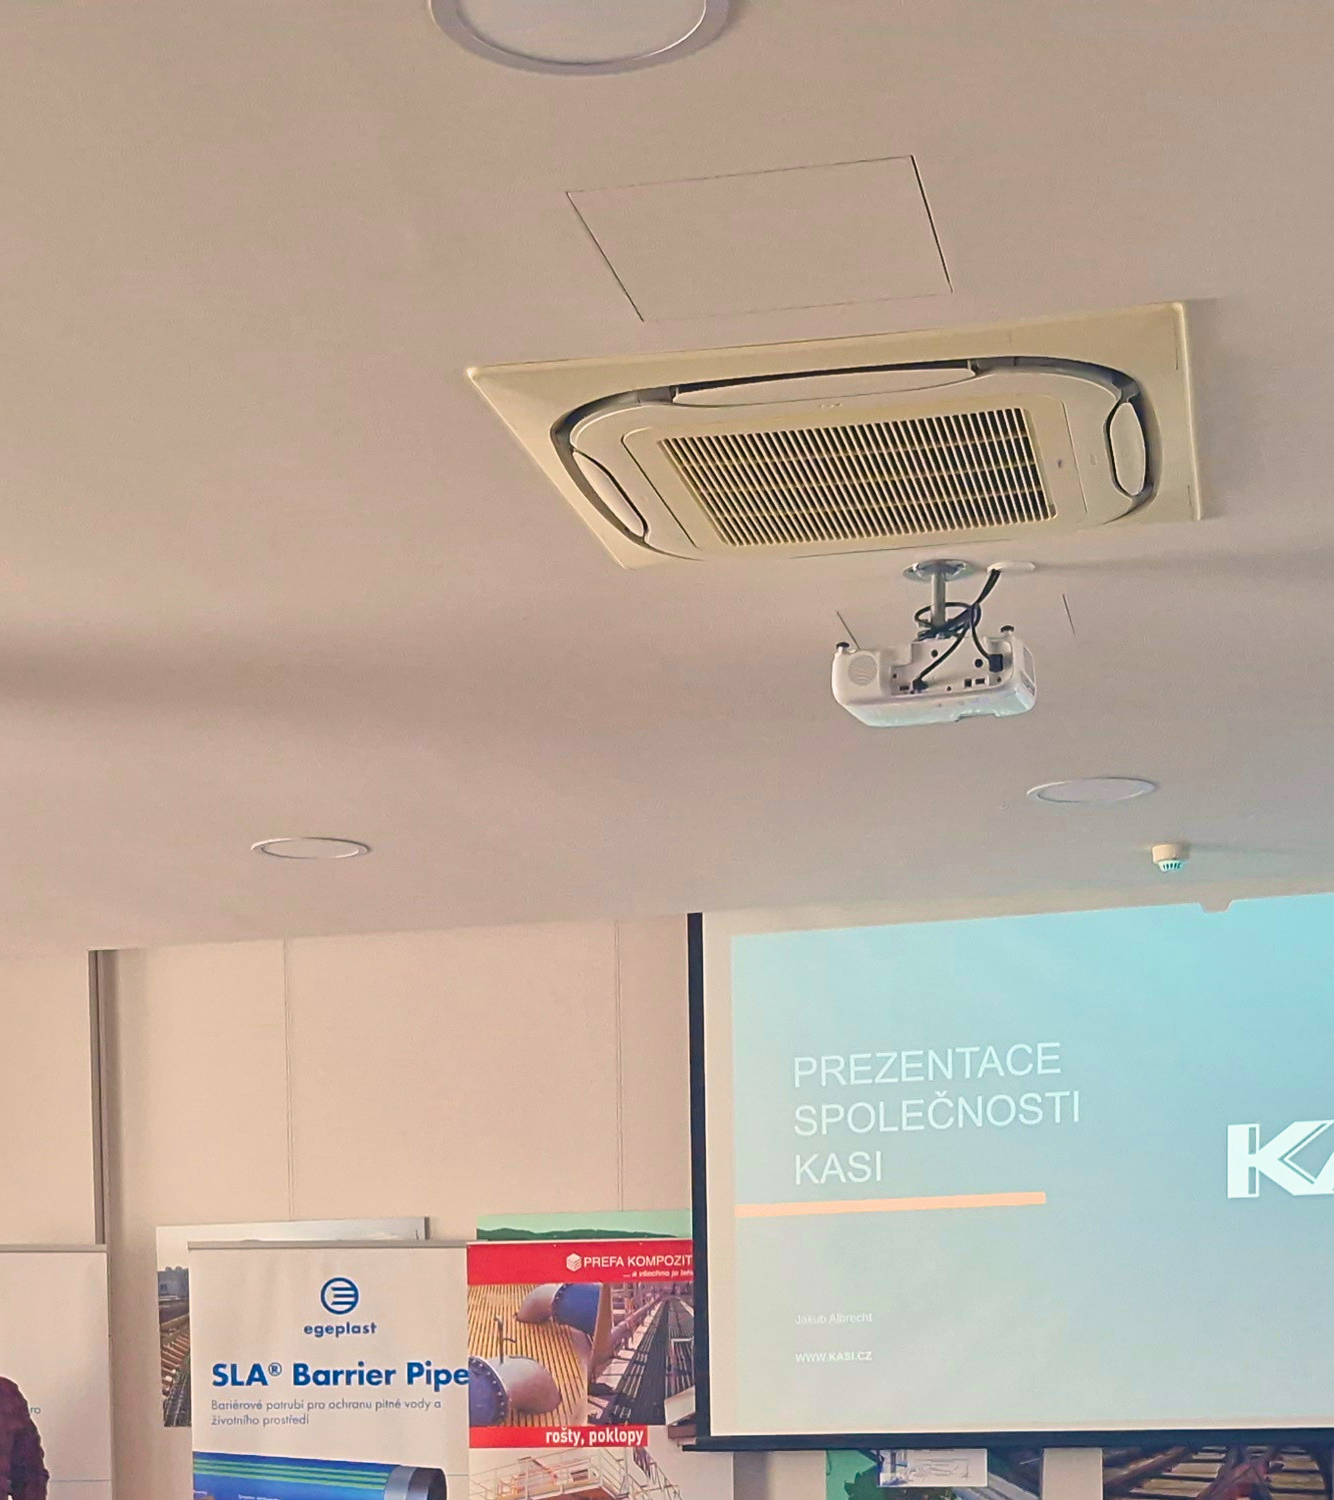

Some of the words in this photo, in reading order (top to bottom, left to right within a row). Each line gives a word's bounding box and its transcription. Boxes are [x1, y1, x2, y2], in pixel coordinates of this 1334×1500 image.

[794, 1042, 1061, 1087] PREZENTACE
[794, 1090, 1078, 1136] SPOLEČNOSTI
[795, 1151, 882, 1185] KASI
[583, 1256, 624, 1267] PREFA
[303, 1322, 377, 1338] egeplast
[293, 1361, 396, 1387] Barrier
[406, 1360, 469, 1392] Pipe
[211, 1398, 263, 1411] Bariérové
[266, 1398, 304, 1412] potrubí
[306, 1401, 325, 1412] pro
[328, 1398, 372, 1410] ochranu
[375, 1398, 401, 1412] pitné
[404, 1398, 431, 1412] vody
[434, 1401, 441, 1409] a
[211, 1413, 260, 1426] životního
[263, 1414, 309, 1428] prostředí
[545, 1427, 585, 1446] rošty,
[589, 1427, 644, 1445] poklopy
